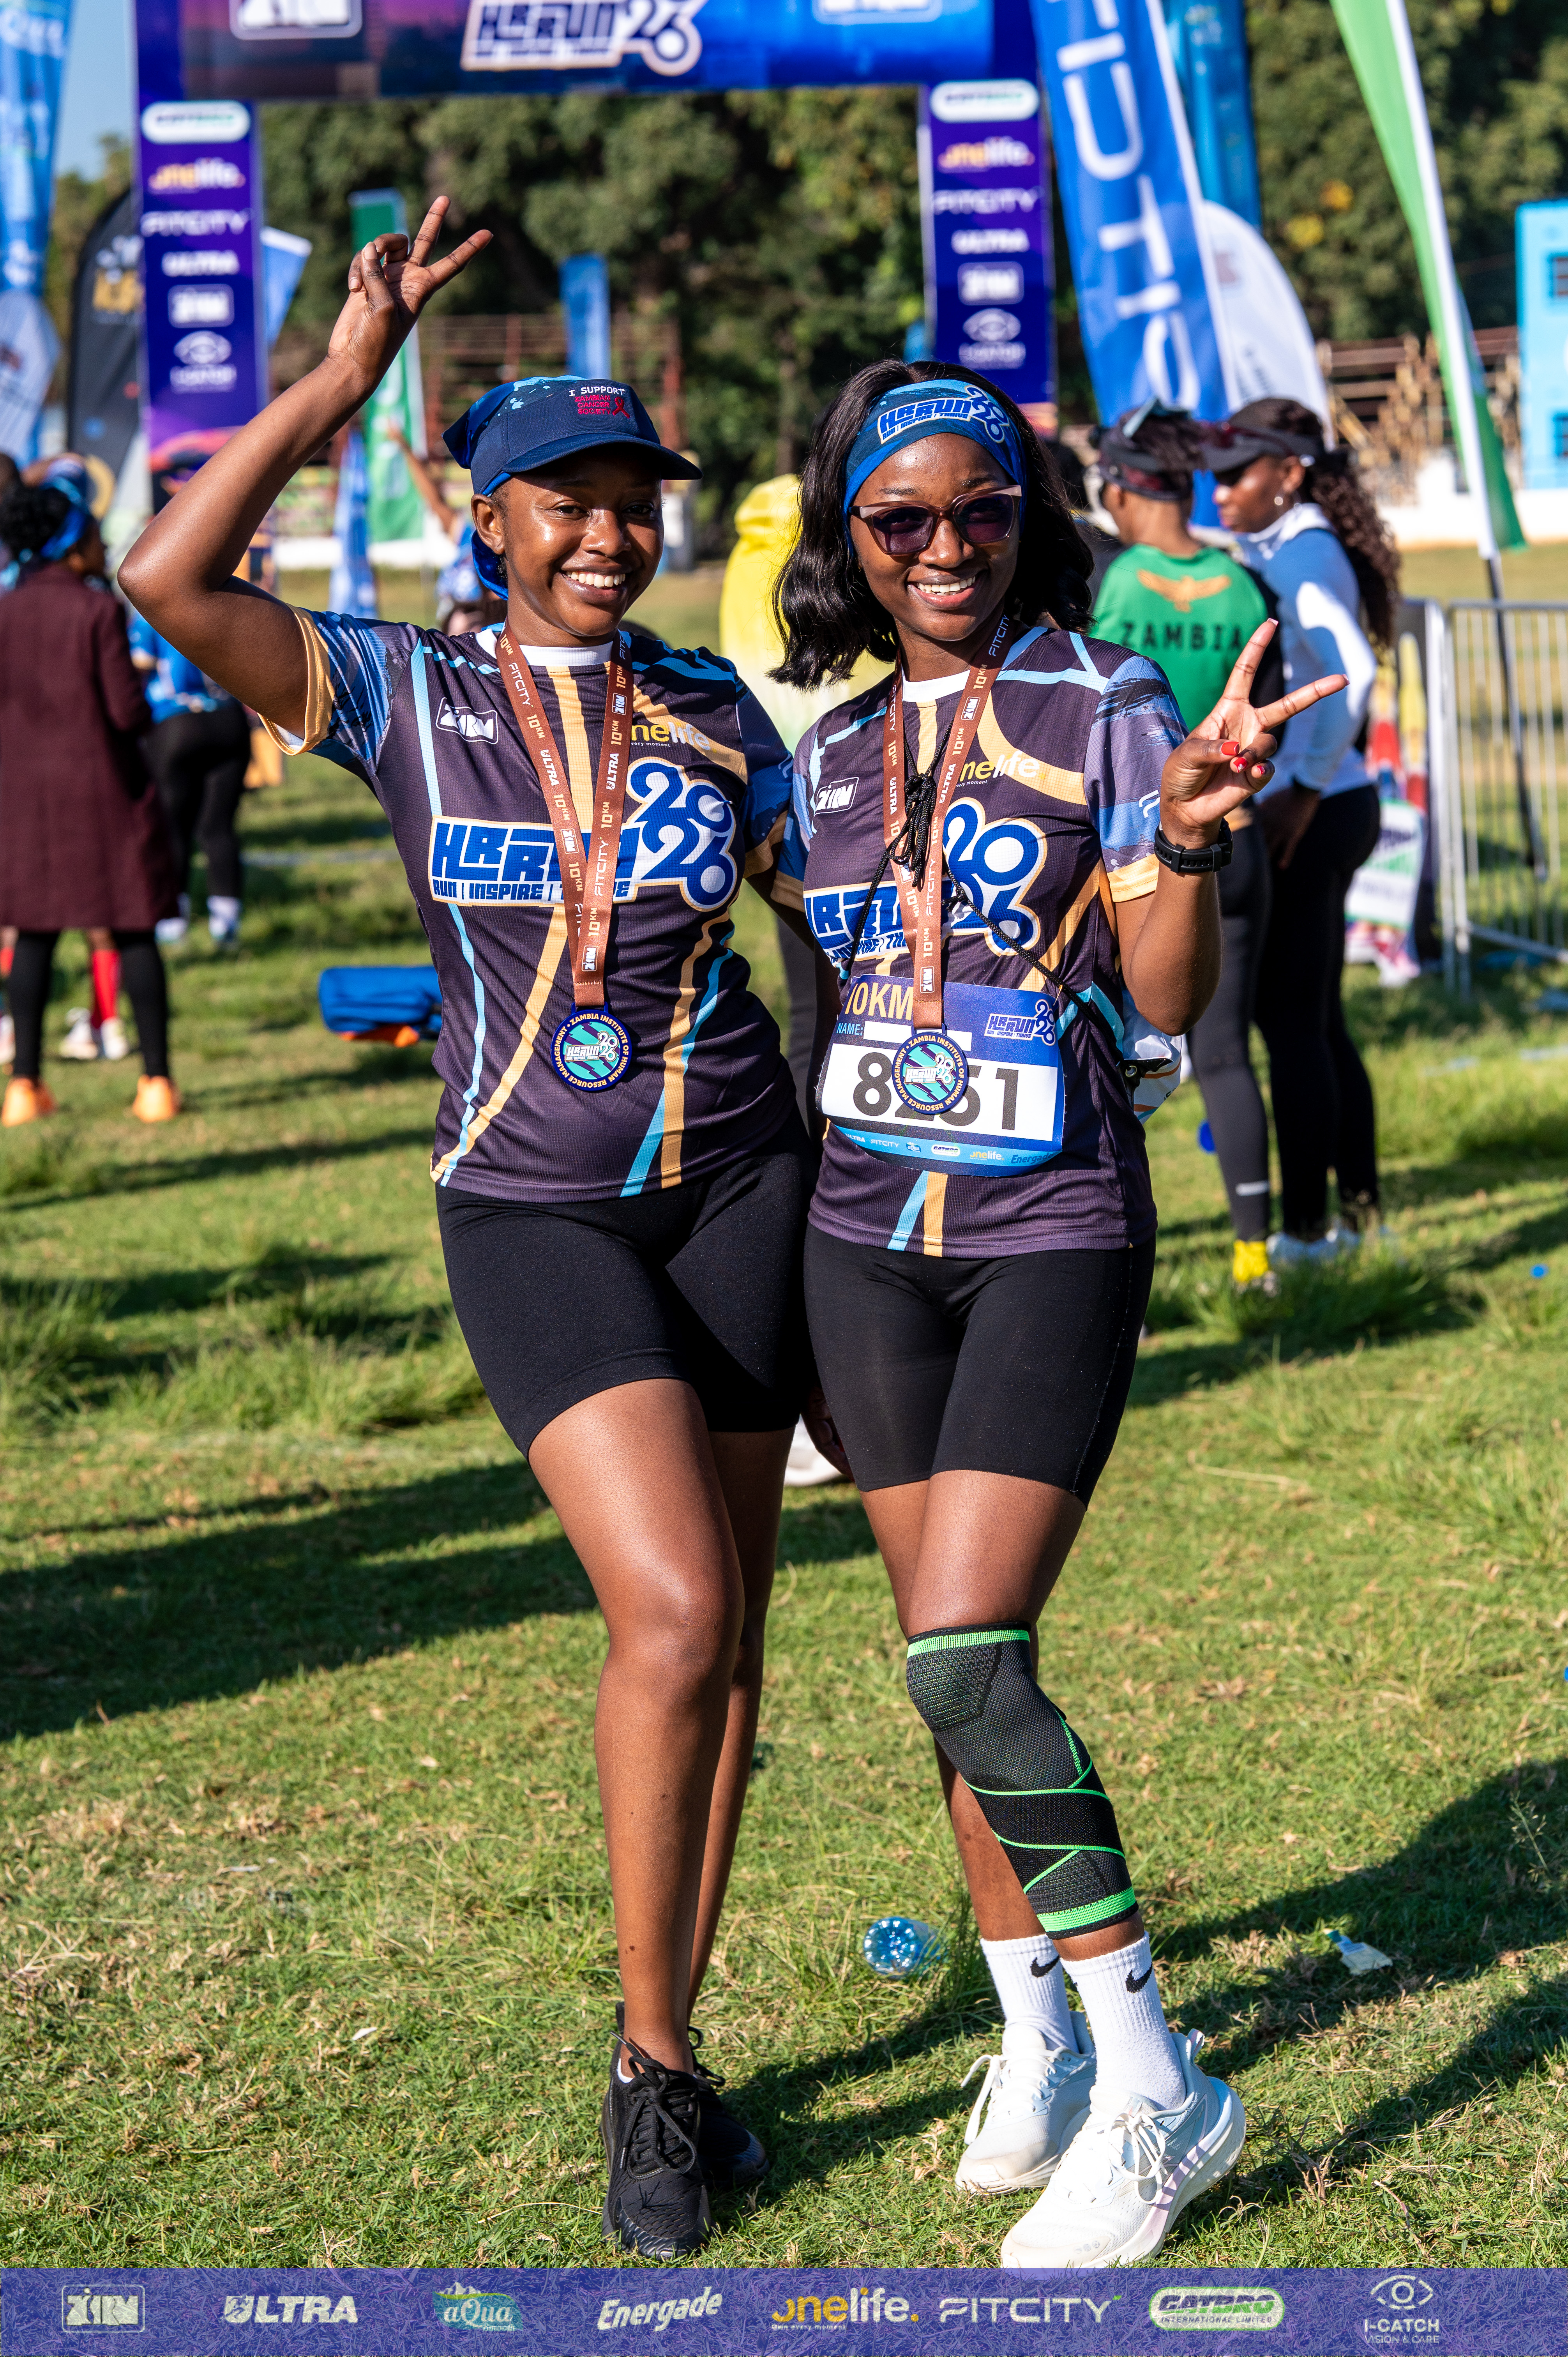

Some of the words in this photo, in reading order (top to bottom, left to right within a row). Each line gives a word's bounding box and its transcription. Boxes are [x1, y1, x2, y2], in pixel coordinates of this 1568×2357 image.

[580, 386, 625, 396] SUPPORT
[882, 427, 896, 440] RUN
[900, 414, 932, 429] INSPIRE
[500, 634, 514, 656] 10KM
[989, 615, 1010, 656] FITCITY
[1121, 620, 1244, 651] ZAMBIA
[509, 662, 531, 706] FITCITY
[616, 665, 626, 689] 10KM
[973, 664, 988, 689] 10KM
[527, 714, 545, 739] 10KM
[611, 720, 622, 745] 10KM
[888, 740, 897, 767] 10KM
[952, 728, 965, 755] 10KM
[540, 749, 560, 786] ULTRA
[606, 753, 619, 790] ULTRA
[939, 763, 956, 804] ULTRA
[553, 793, 570, 820] 10KM
[601, 801, 613, 828] 10KM
[890, 820, 904, 849] 10M
[569, 862, 583, 892] 10KM
[594, 839, 609, 896] FITCITY
[432, 879, 457, 898] RUN
[469, 883, 543, 900] INSPIRE
[925, 857, 936, 916] FITCITY
[588, 907, 600, 937] 10KM
[923, 928, 933, 958] 10KM
[569, 1013, 599, 1026] ZAMBIA
[600, 1014, 628, 1044] INSTITUTE
[836, 1022, 863, 1036] NAME:
[554, 1026, 570, 1076] MANAGEMENT
[623, 1045, 629, 1055] OF
[908, 1035, 936, 1048] ZAMBIA
[937, 1037, 963, 1067] INSTITUTE
[568, 1074, 607, 1088] RESOURCE
[607, 1057, 628, 1082] HUMAN
[894, 1048, 909, 1101] MANAGEMENT
[959, 1068, 964, 1079] OF
[907, 1098, 944, 1111] RESOURCE
[945, 1080, 964, 1106] HUMAN
[871, 1139, 899, 1148] FITCITY
